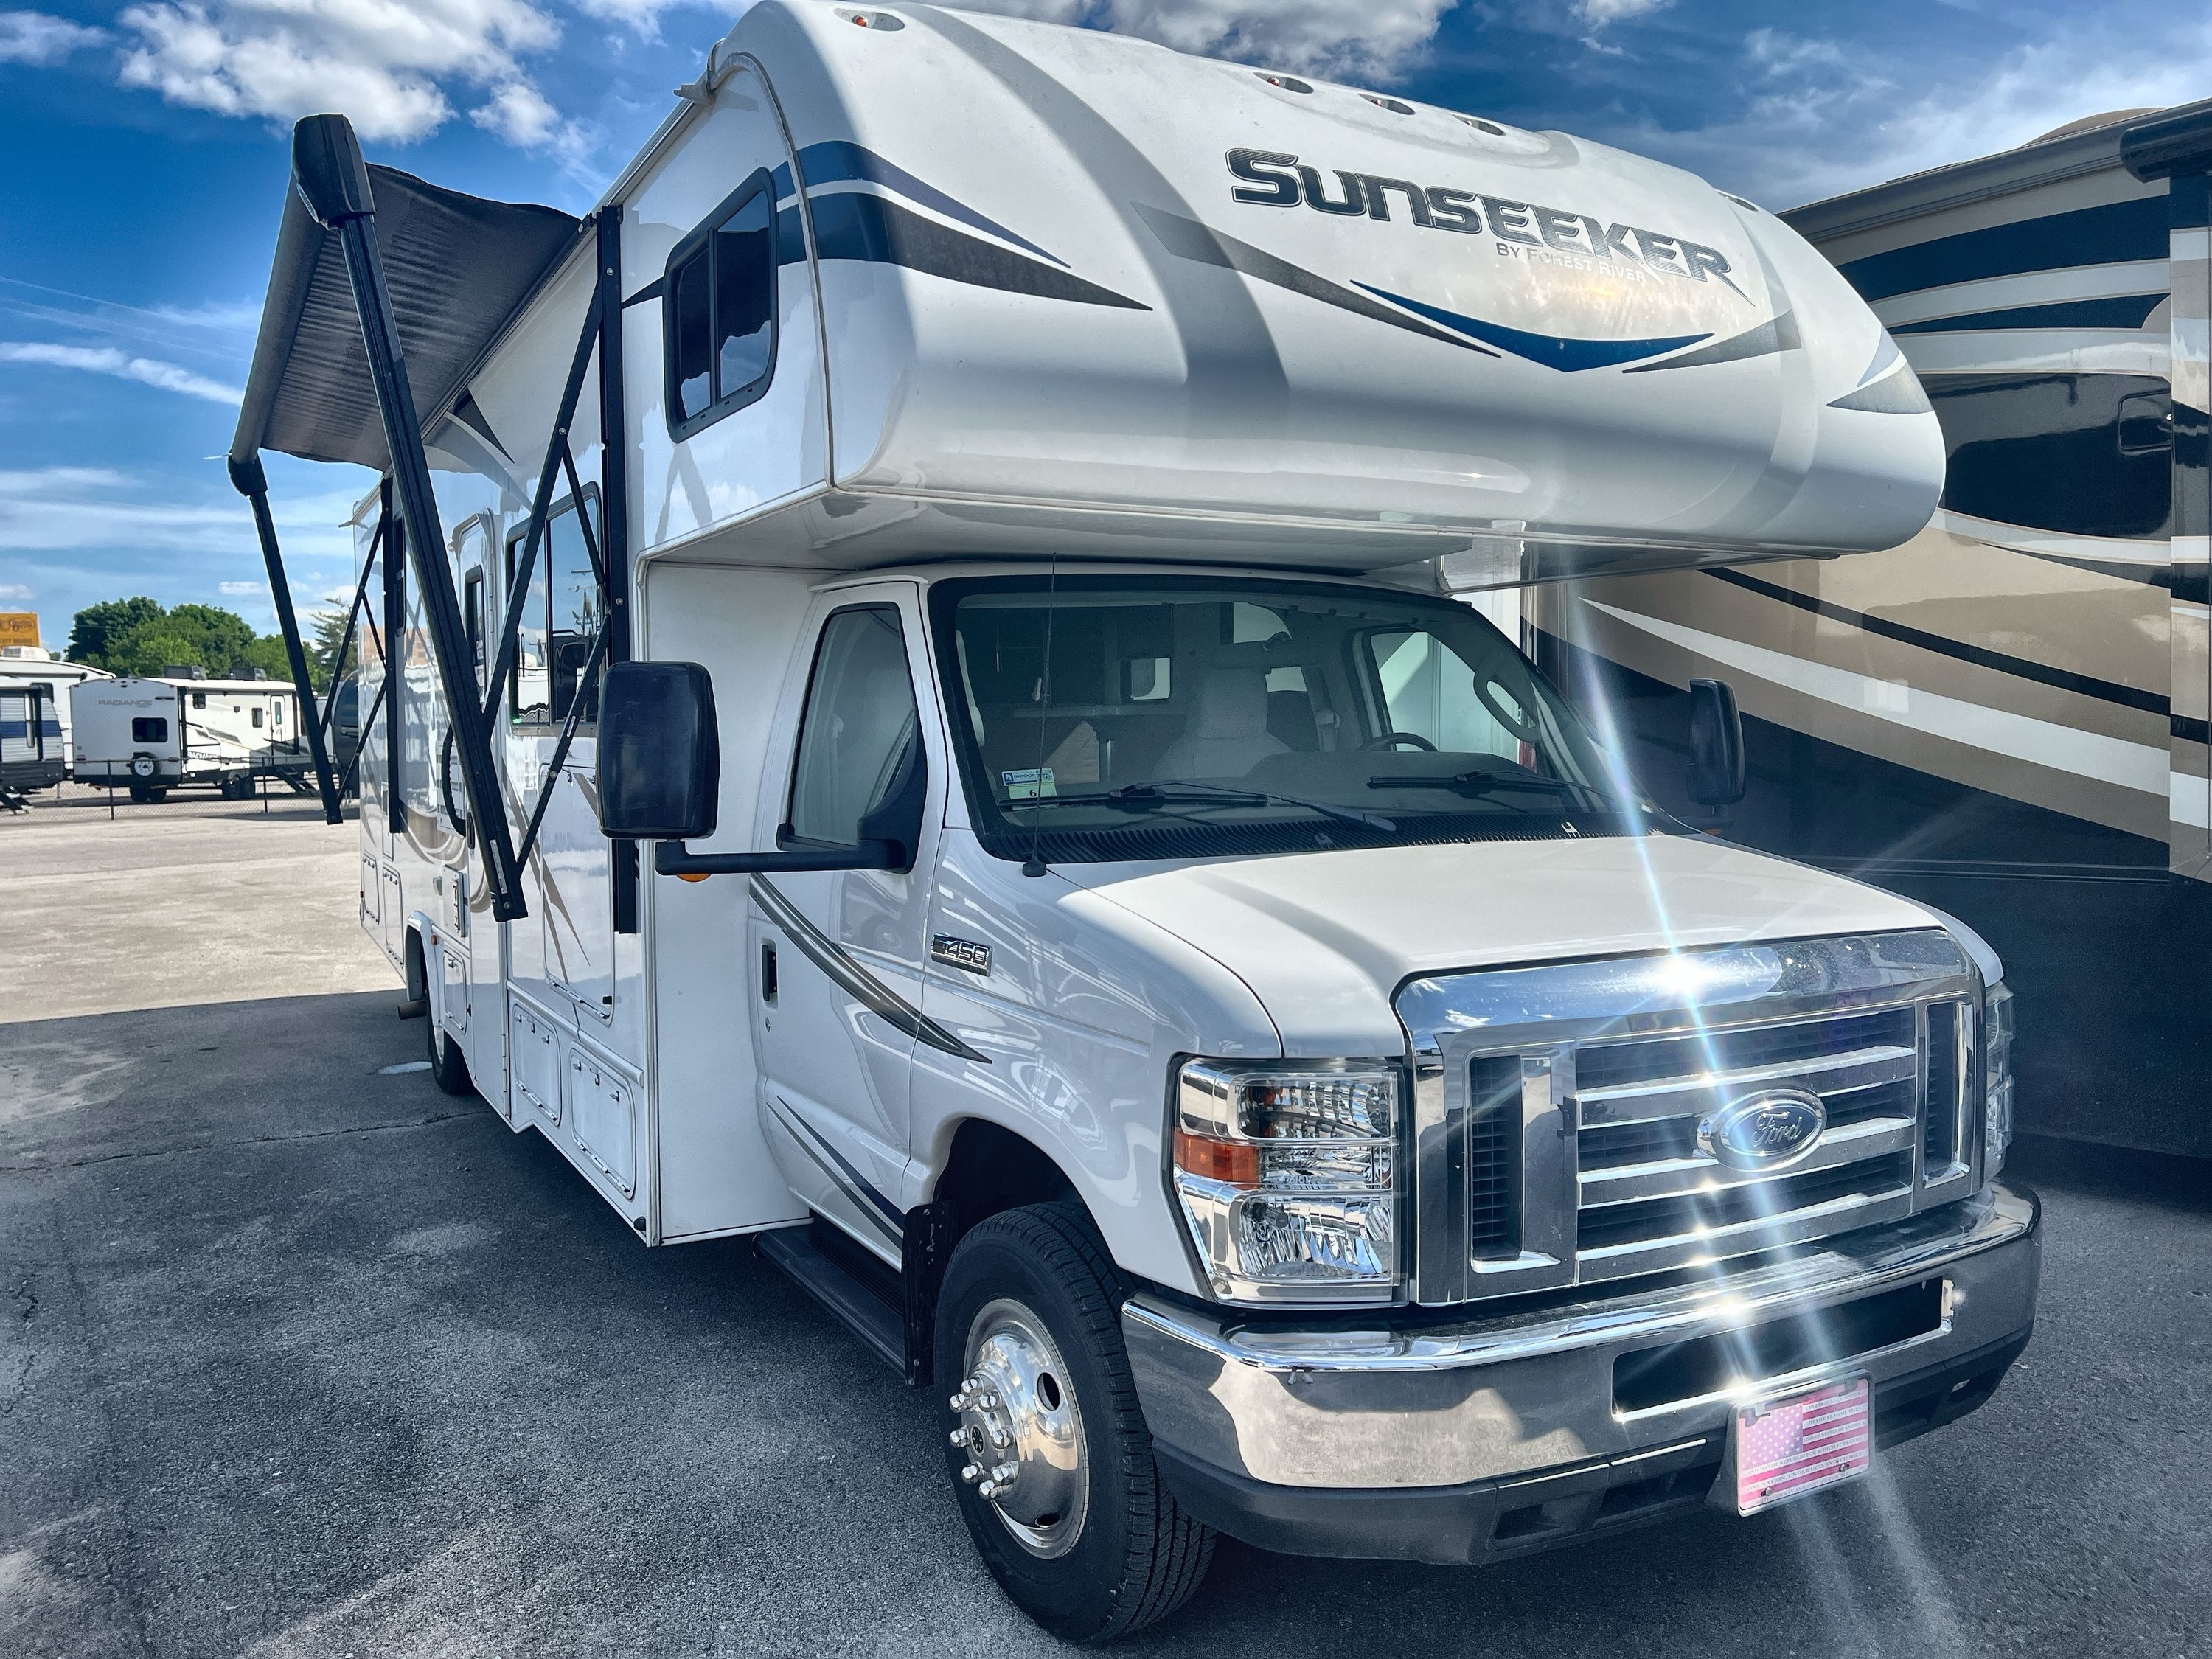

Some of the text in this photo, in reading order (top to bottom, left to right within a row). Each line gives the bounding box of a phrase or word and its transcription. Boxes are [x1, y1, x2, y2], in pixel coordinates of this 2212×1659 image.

[1495, 242, 1520, 259] BY
[1599, 260, 1646, 283] RIVER
[1029, 789, 1037, 797] 6
[1752, 1111, 1804, 1147] Ford
